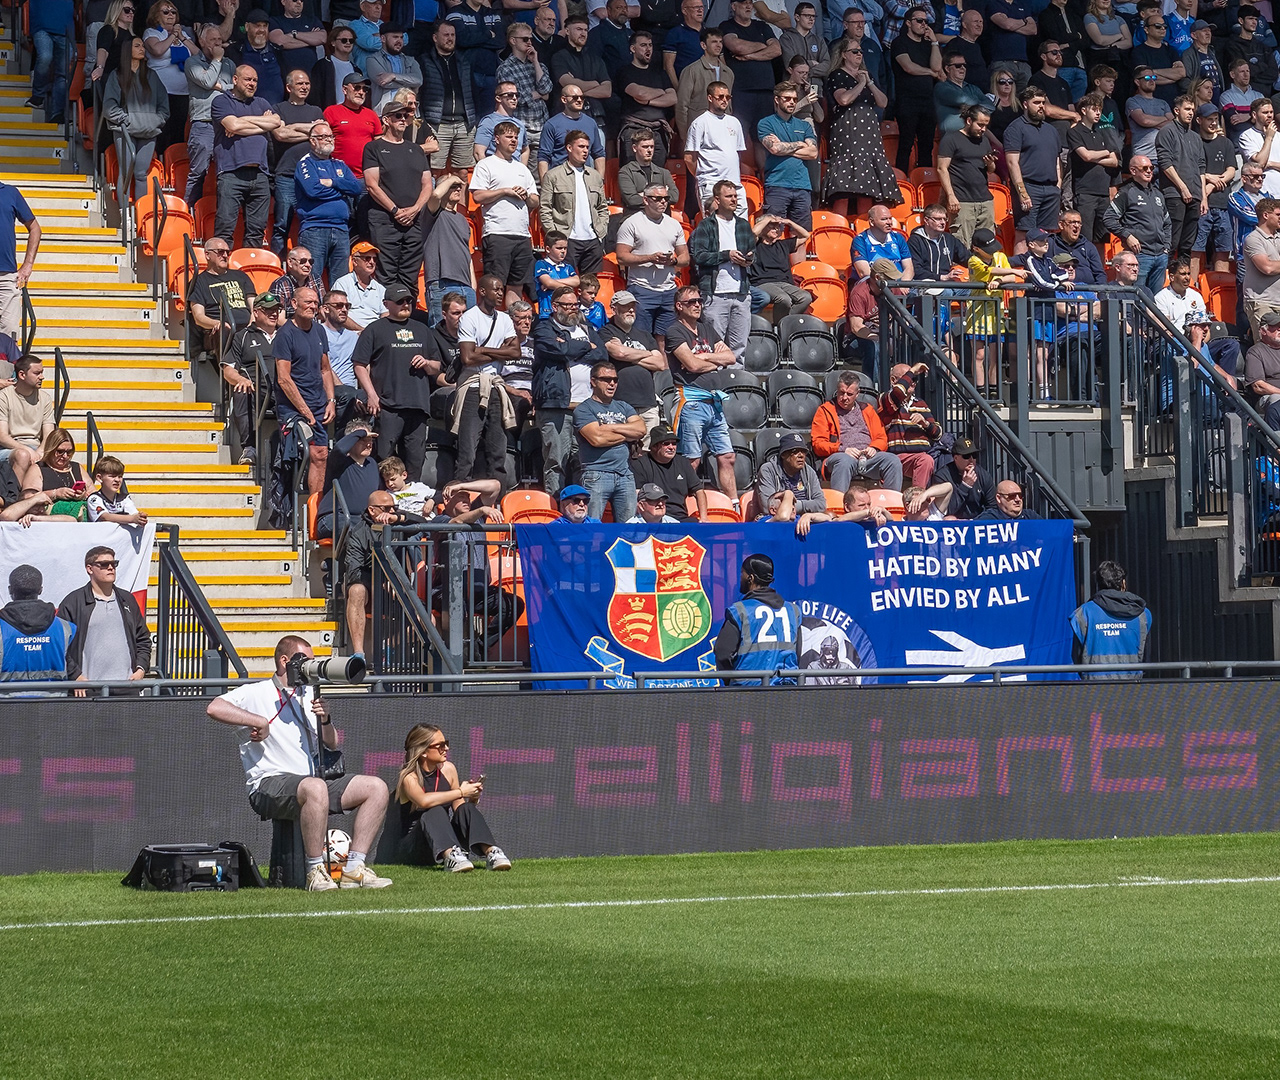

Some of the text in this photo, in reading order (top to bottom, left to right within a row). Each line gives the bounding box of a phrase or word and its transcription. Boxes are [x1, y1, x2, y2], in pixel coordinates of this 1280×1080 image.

[83, 201, 89, 209] J
[143, 310, 150, 319] H
[175, 370, 182, 379] G
[211, 433, 217, 441] F
[247, 496, 253, 504] E
[865, 522, 1019, 549] LOVED BY FEW
[284, 562, 290, 571] D
[868, 547, 1042, 579] HATED BY MANY
[871, 583, 1030, 611] ENVIED BY ALL
[801, 600, 853, 631] OF LIFE
[755, 606, 792, 643] 21
[1095, 622, 1127, 630] RESPONSE
[16, 636, 51, 644] RESPONSE
[323, 633, 330, 642] C
[334, 713, 1259, 822] telligiants
